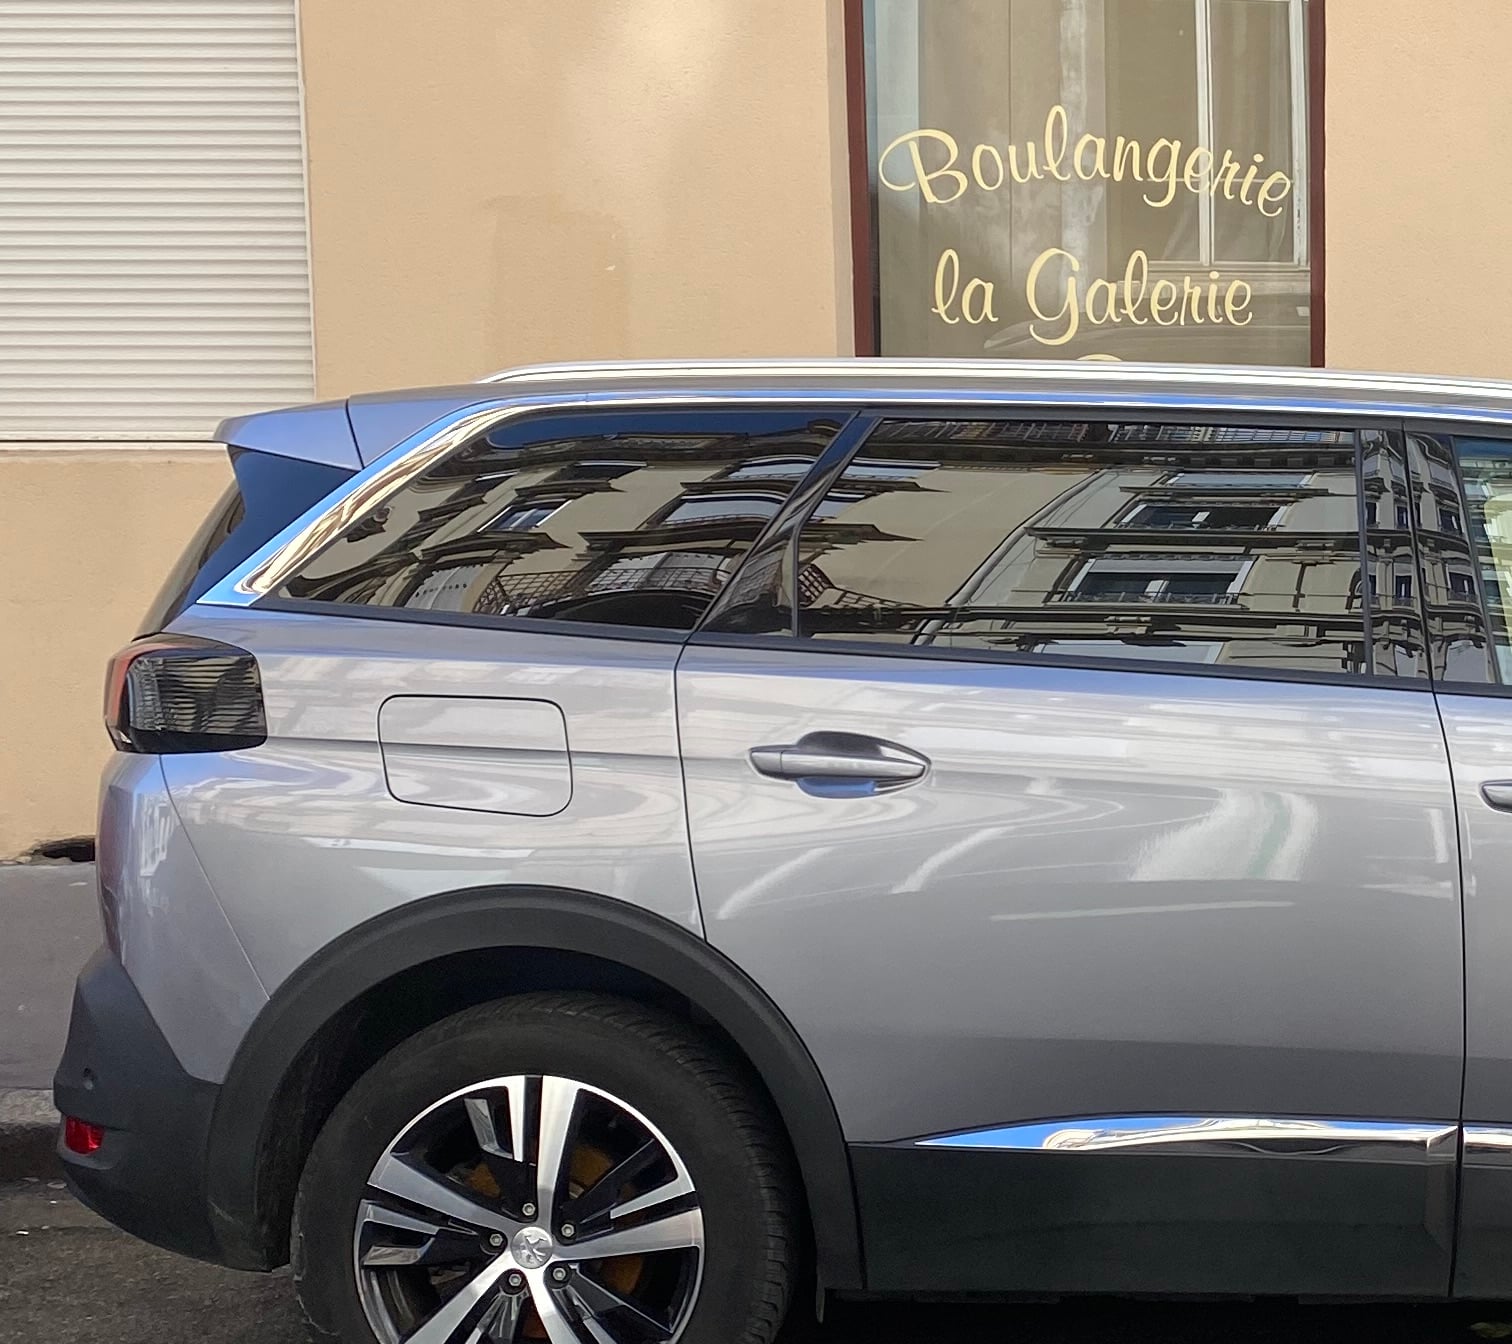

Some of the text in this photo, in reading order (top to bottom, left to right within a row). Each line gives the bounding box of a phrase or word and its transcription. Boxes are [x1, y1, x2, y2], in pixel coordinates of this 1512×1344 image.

[879, 104, 1292, 218] Boulangerie
[931, 247, 1254, 347] la Galerie
